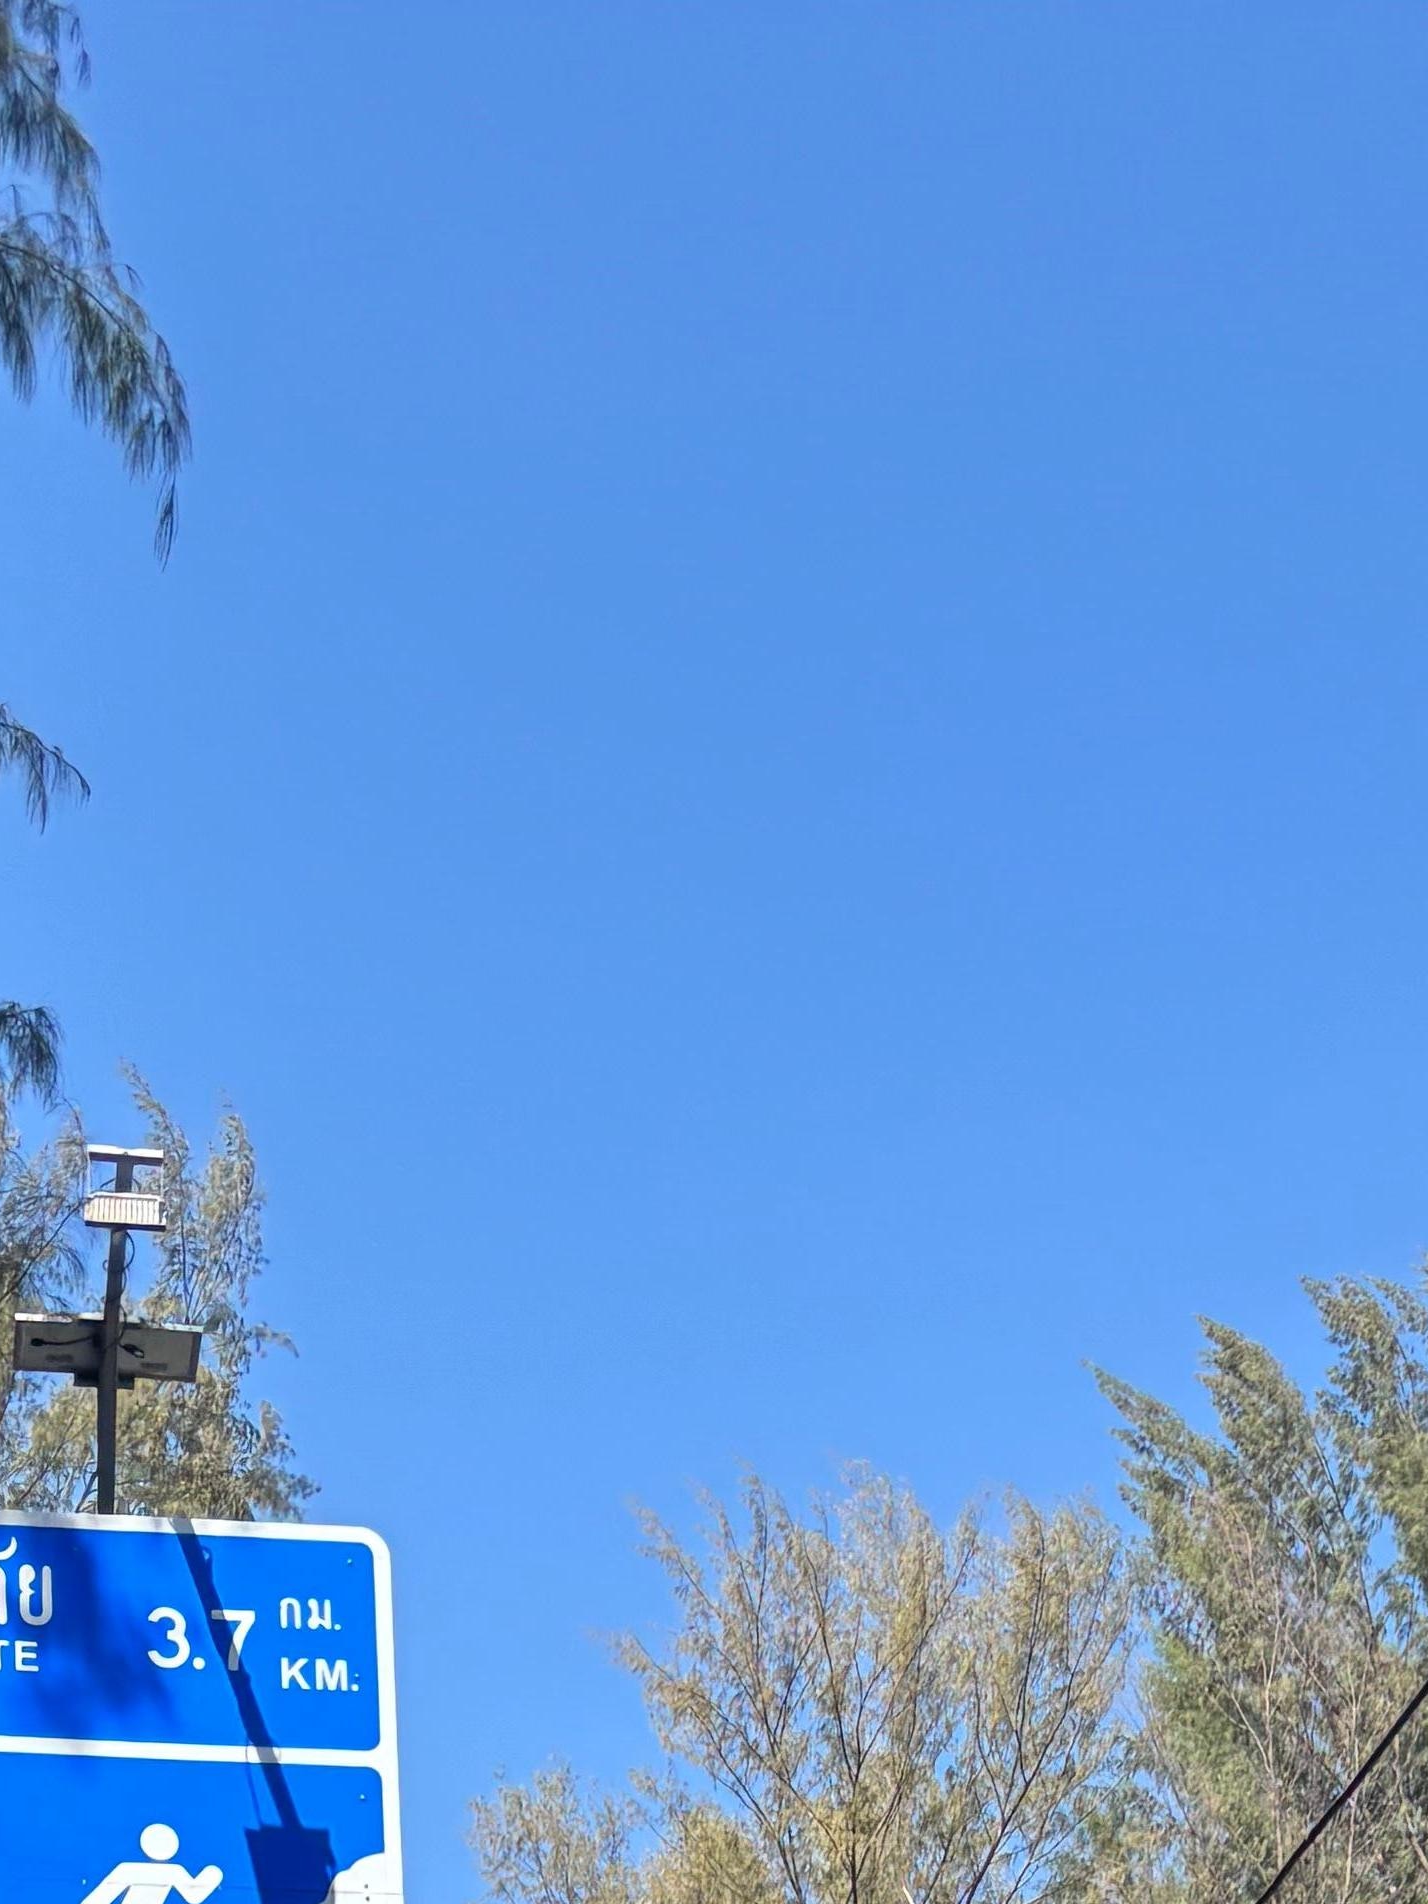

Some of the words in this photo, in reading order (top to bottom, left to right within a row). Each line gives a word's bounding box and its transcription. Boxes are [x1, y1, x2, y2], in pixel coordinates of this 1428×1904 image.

[279, 1597, 342, 1631] กม.
[147, 1606, 256, 1671] 3.7
[280, 1657, 360, 1692] KM.
